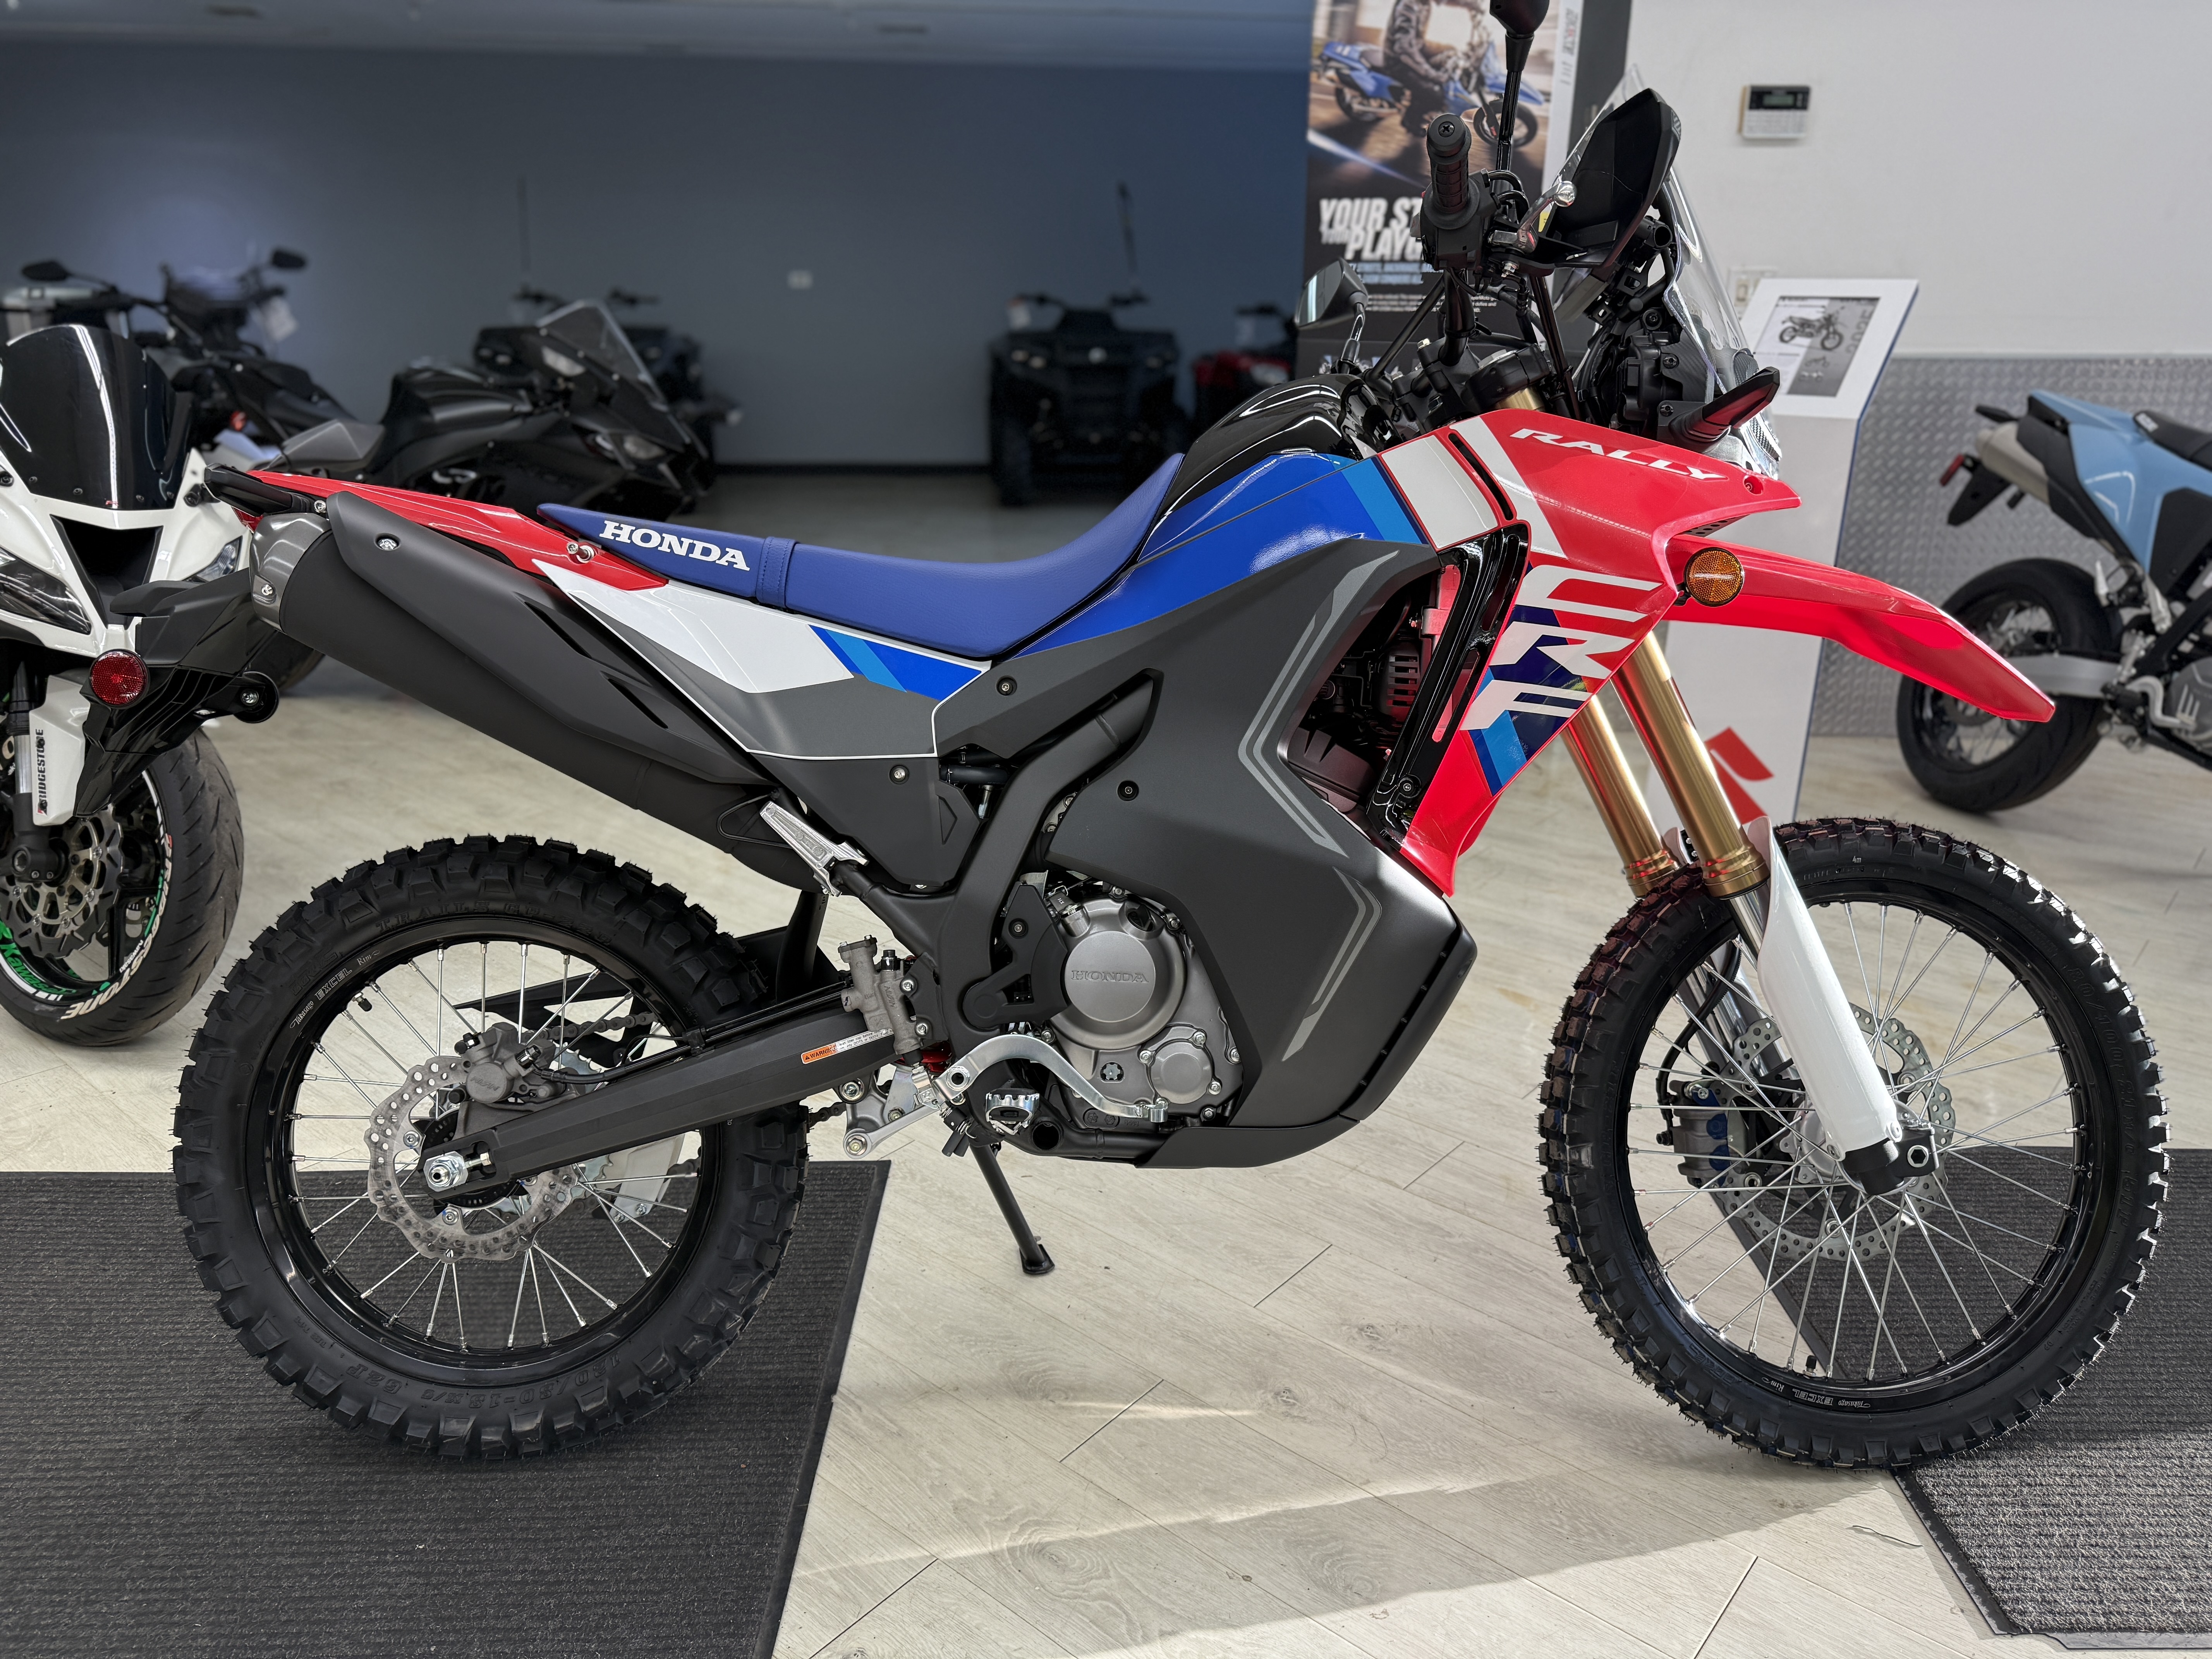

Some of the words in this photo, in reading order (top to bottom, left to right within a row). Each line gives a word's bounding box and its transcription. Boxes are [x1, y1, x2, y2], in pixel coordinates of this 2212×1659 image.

[1319, 197, 1389, 232] YOUR
[1510, 428, 1728, 480] RALLY
[599, 520, 750, 571] HONDA
[1460, 565, 1664, 731] CRF
[35, 729, 48, 816] RIDGESTOE
[290, 1001, 314, 1029] Takasago
[314, 968, 352, 1000] EXCEL
[356, 950, 380, 966] Rim
[1072, 970, 1149, 983] HONDA
[809, 1046, 837, 1059] WARNING
[1762, 1377, 1784, 1392] Rim
[1792, 1388, 1834, 1406] EXCEL
[1838, 1399, 1871, 1408] Takasago
